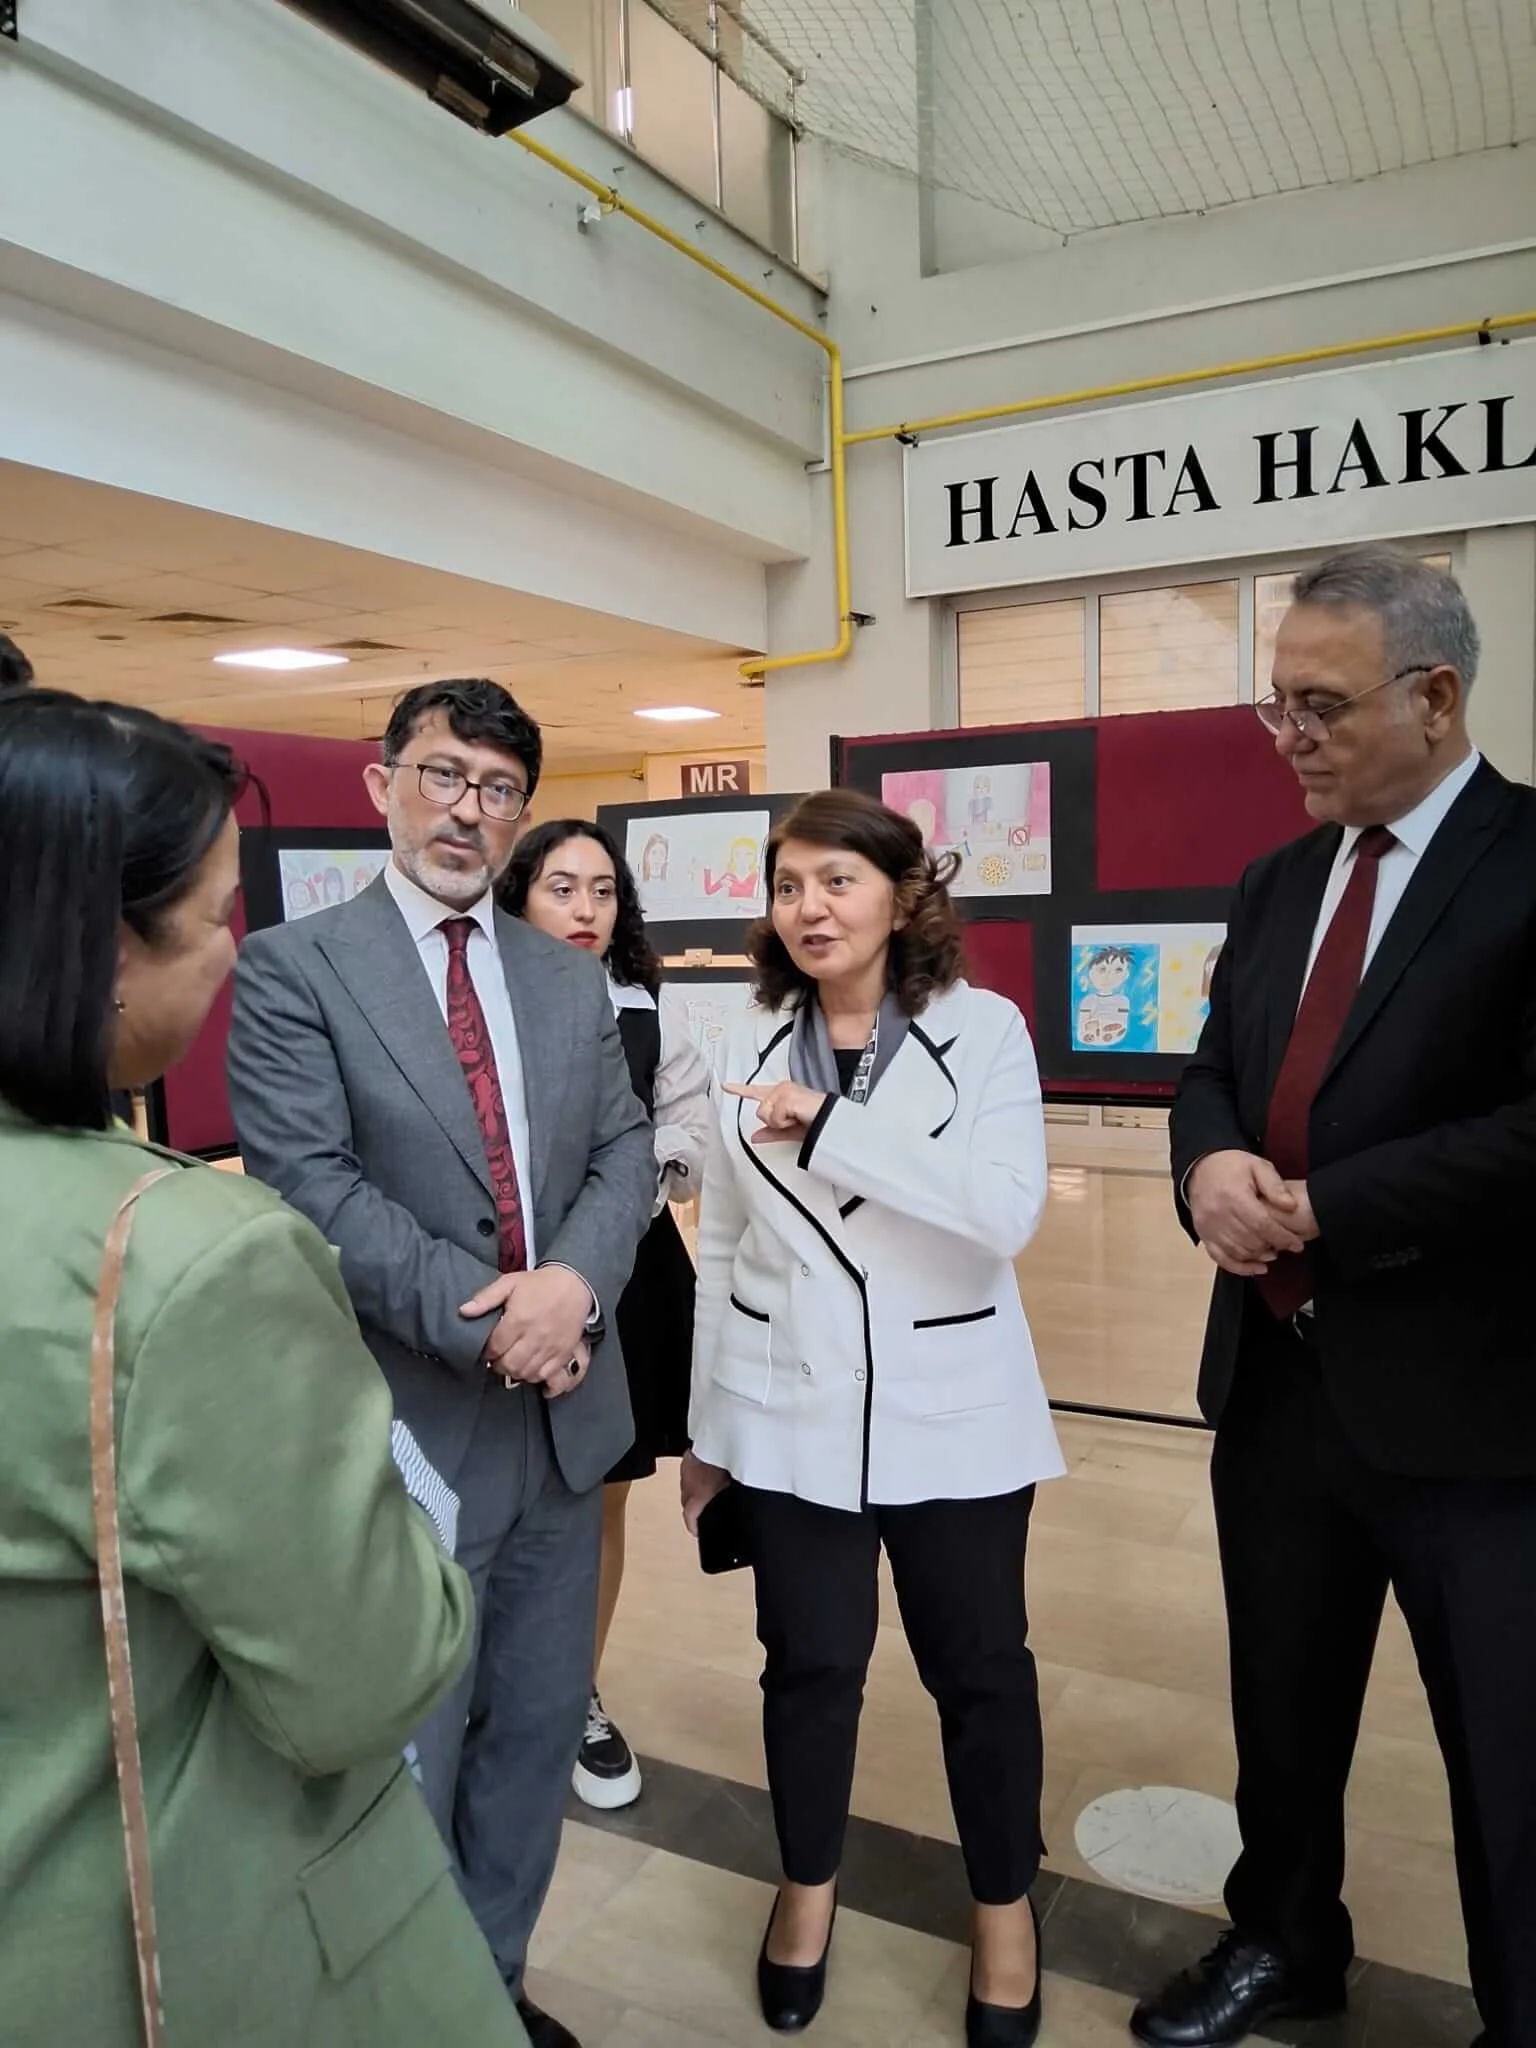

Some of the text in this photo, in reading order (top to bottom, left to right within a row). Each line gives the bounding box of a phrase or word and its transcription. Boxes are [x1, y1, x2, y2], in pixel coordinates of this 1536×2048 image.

[944, 396, 1536, 547] HASTA HAKL
[690, 764, 739, 793] MR
